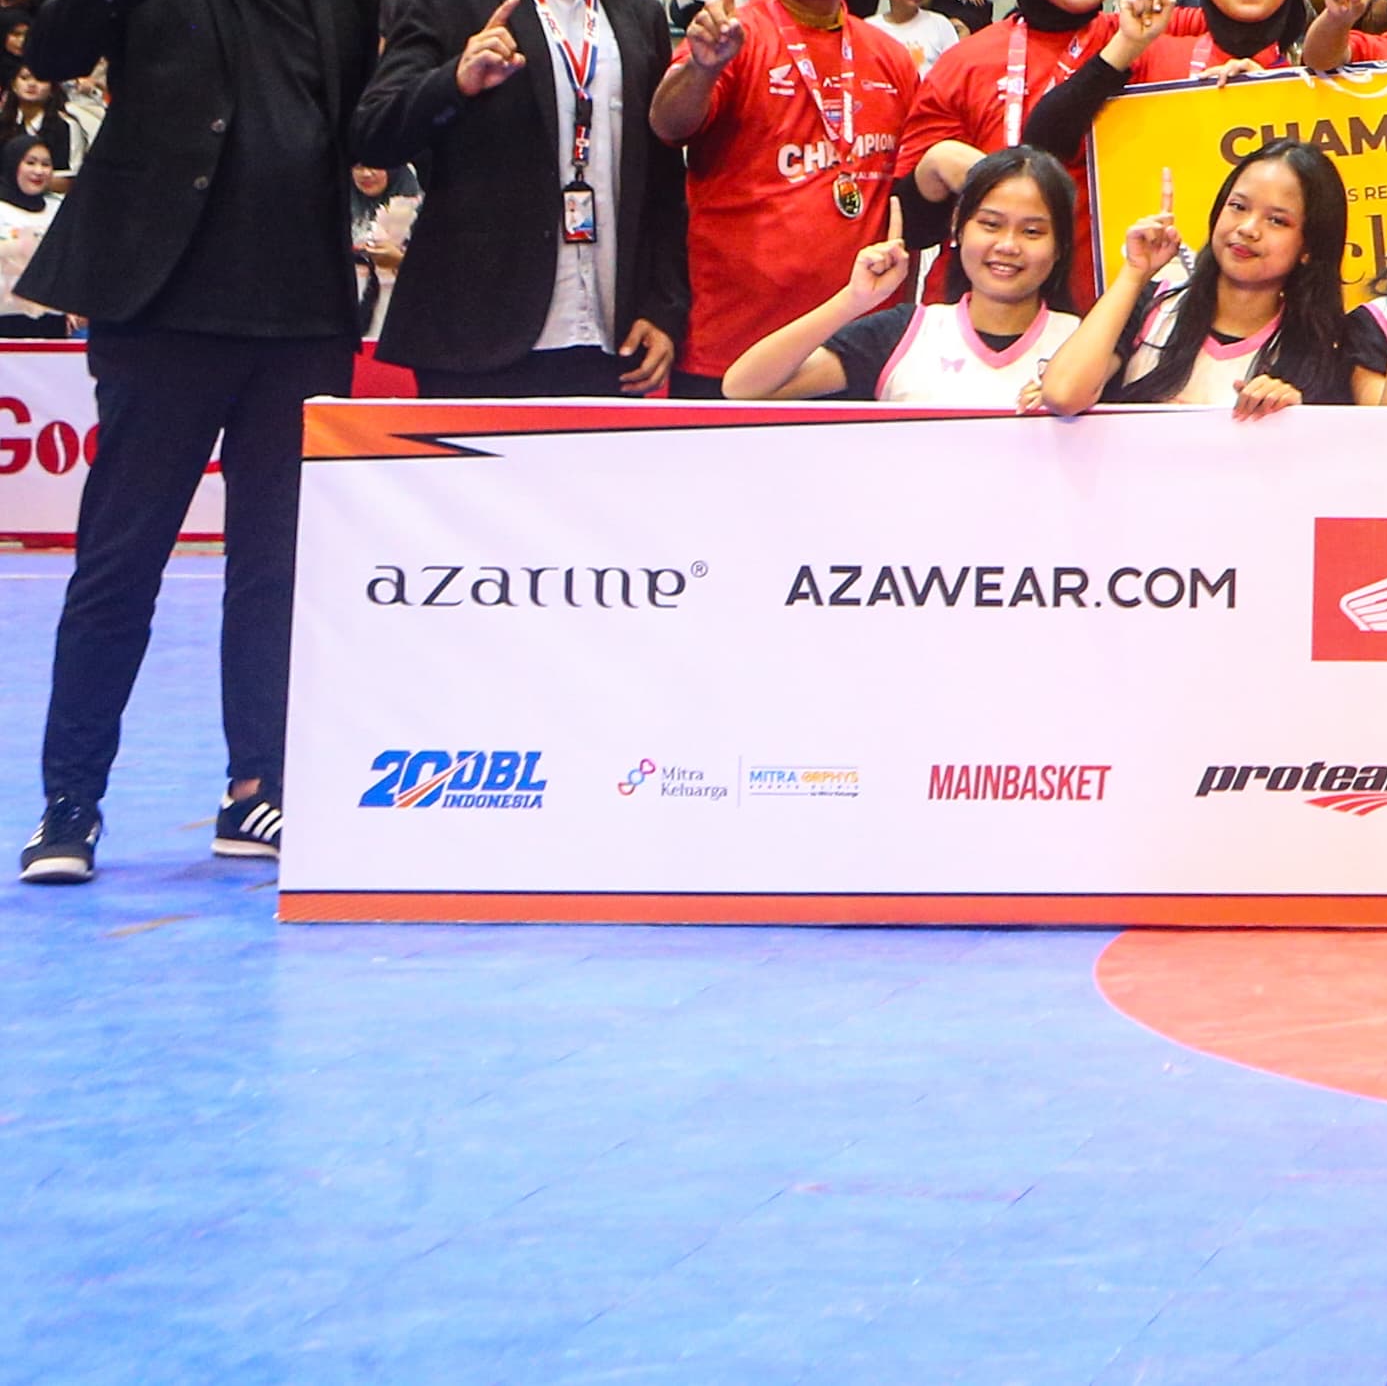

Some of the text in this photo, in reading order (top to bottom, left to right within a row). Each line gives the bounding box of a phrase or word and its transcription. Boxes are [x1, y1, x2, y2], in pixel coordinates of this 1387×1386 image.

[0, 396, 99, 475] Go
[785, 565, 1236, 608] AZAWEAR.COM
[662, 767, 704, 780] Mitra
[750, 771, 796, 782] MITRA
[928, 765, 1112, 800] MAINBASKET
[661, 783, 727, 800] Keluarga
[442, 794, 542, 808] INDONESIA
